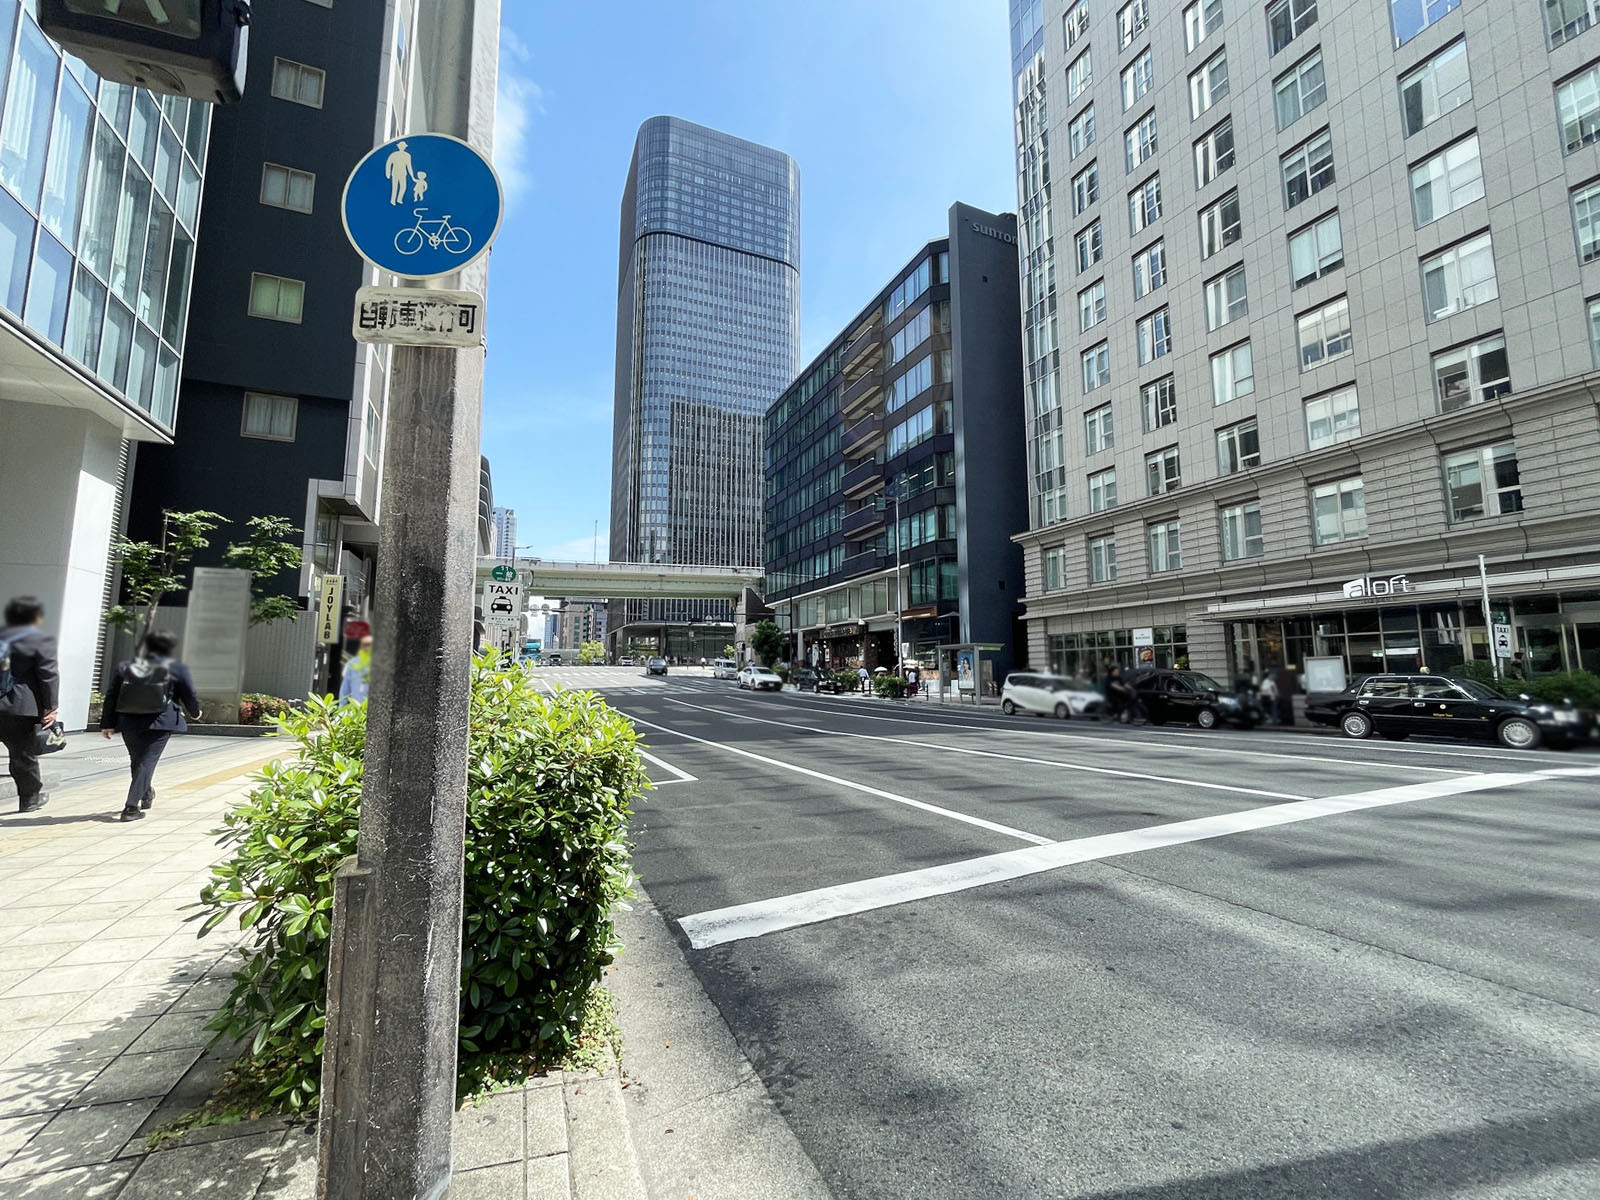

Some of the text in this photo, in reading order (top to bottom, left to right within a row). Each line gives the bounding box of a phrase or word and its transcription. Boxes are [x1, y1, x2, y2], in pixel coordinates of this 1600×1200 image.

[972, 222, 1018, 245] SUNTOR
[489, 585, 519, 595] TAXI
[1343, 574, 1409, 598] aloft
[323, 587, 334, 639] JOYLAB
